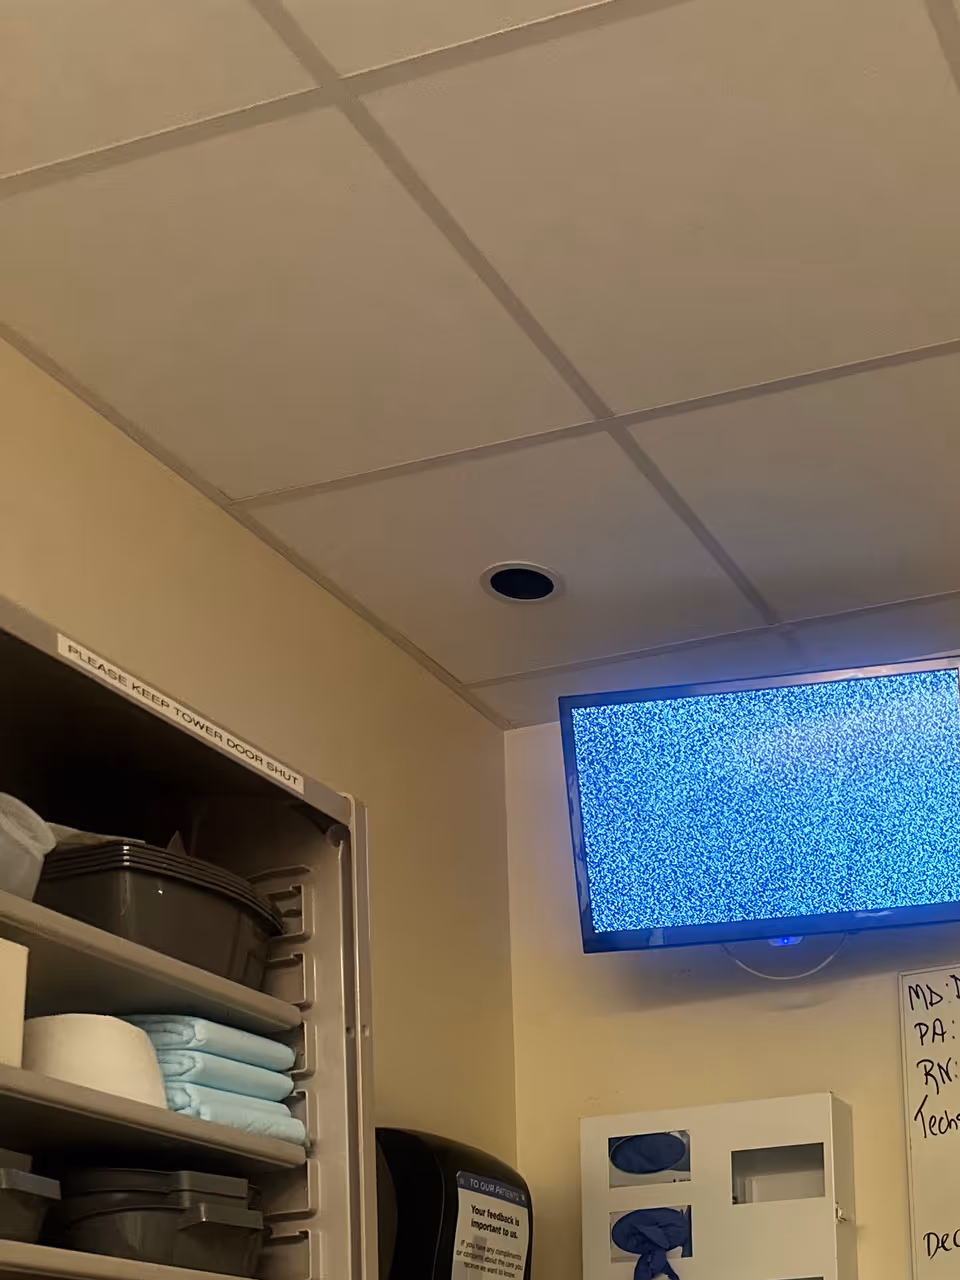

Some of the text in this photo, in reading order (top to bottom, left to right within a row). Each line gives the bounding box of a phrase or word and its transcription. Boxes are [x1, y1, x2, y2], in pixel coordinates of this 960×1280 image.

[68, 644, 298, 786] PLEASE KEEP TOWER DOOR SHUT
[914, 1018, 956, 1046] PA:
[916, 1057, 958, 1095] RN:
[470, 1179, 479, 1188] TO
[480, 1182, 494, 1192] OUR
[471, 1204, 519, 1226] Your feedback is
[471, 1218, 502, 1234] important
[503, 1227, 509, 1236] to
